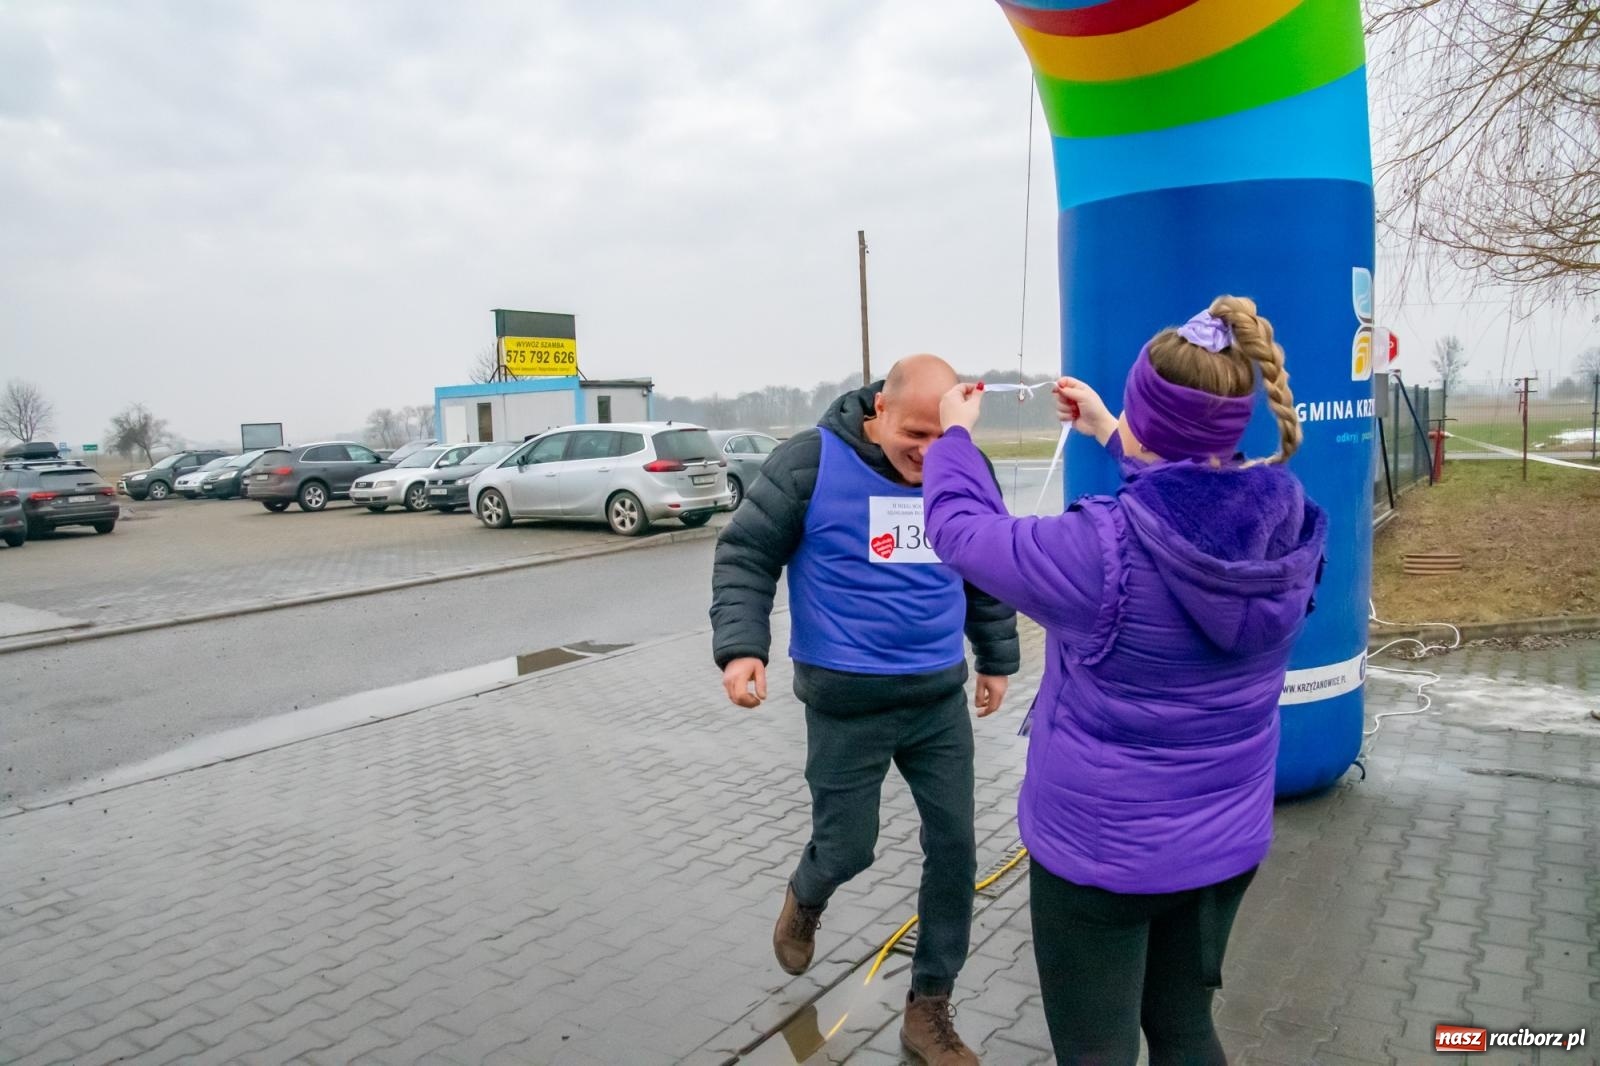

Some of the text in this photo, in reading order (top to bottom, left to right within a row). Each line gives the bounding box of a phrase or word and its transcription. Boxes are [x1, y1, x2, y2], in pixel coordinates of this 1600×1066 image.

[506, 350, 575, 364] 575 792 626
[1295, 400, 1354, 422] GMINA
